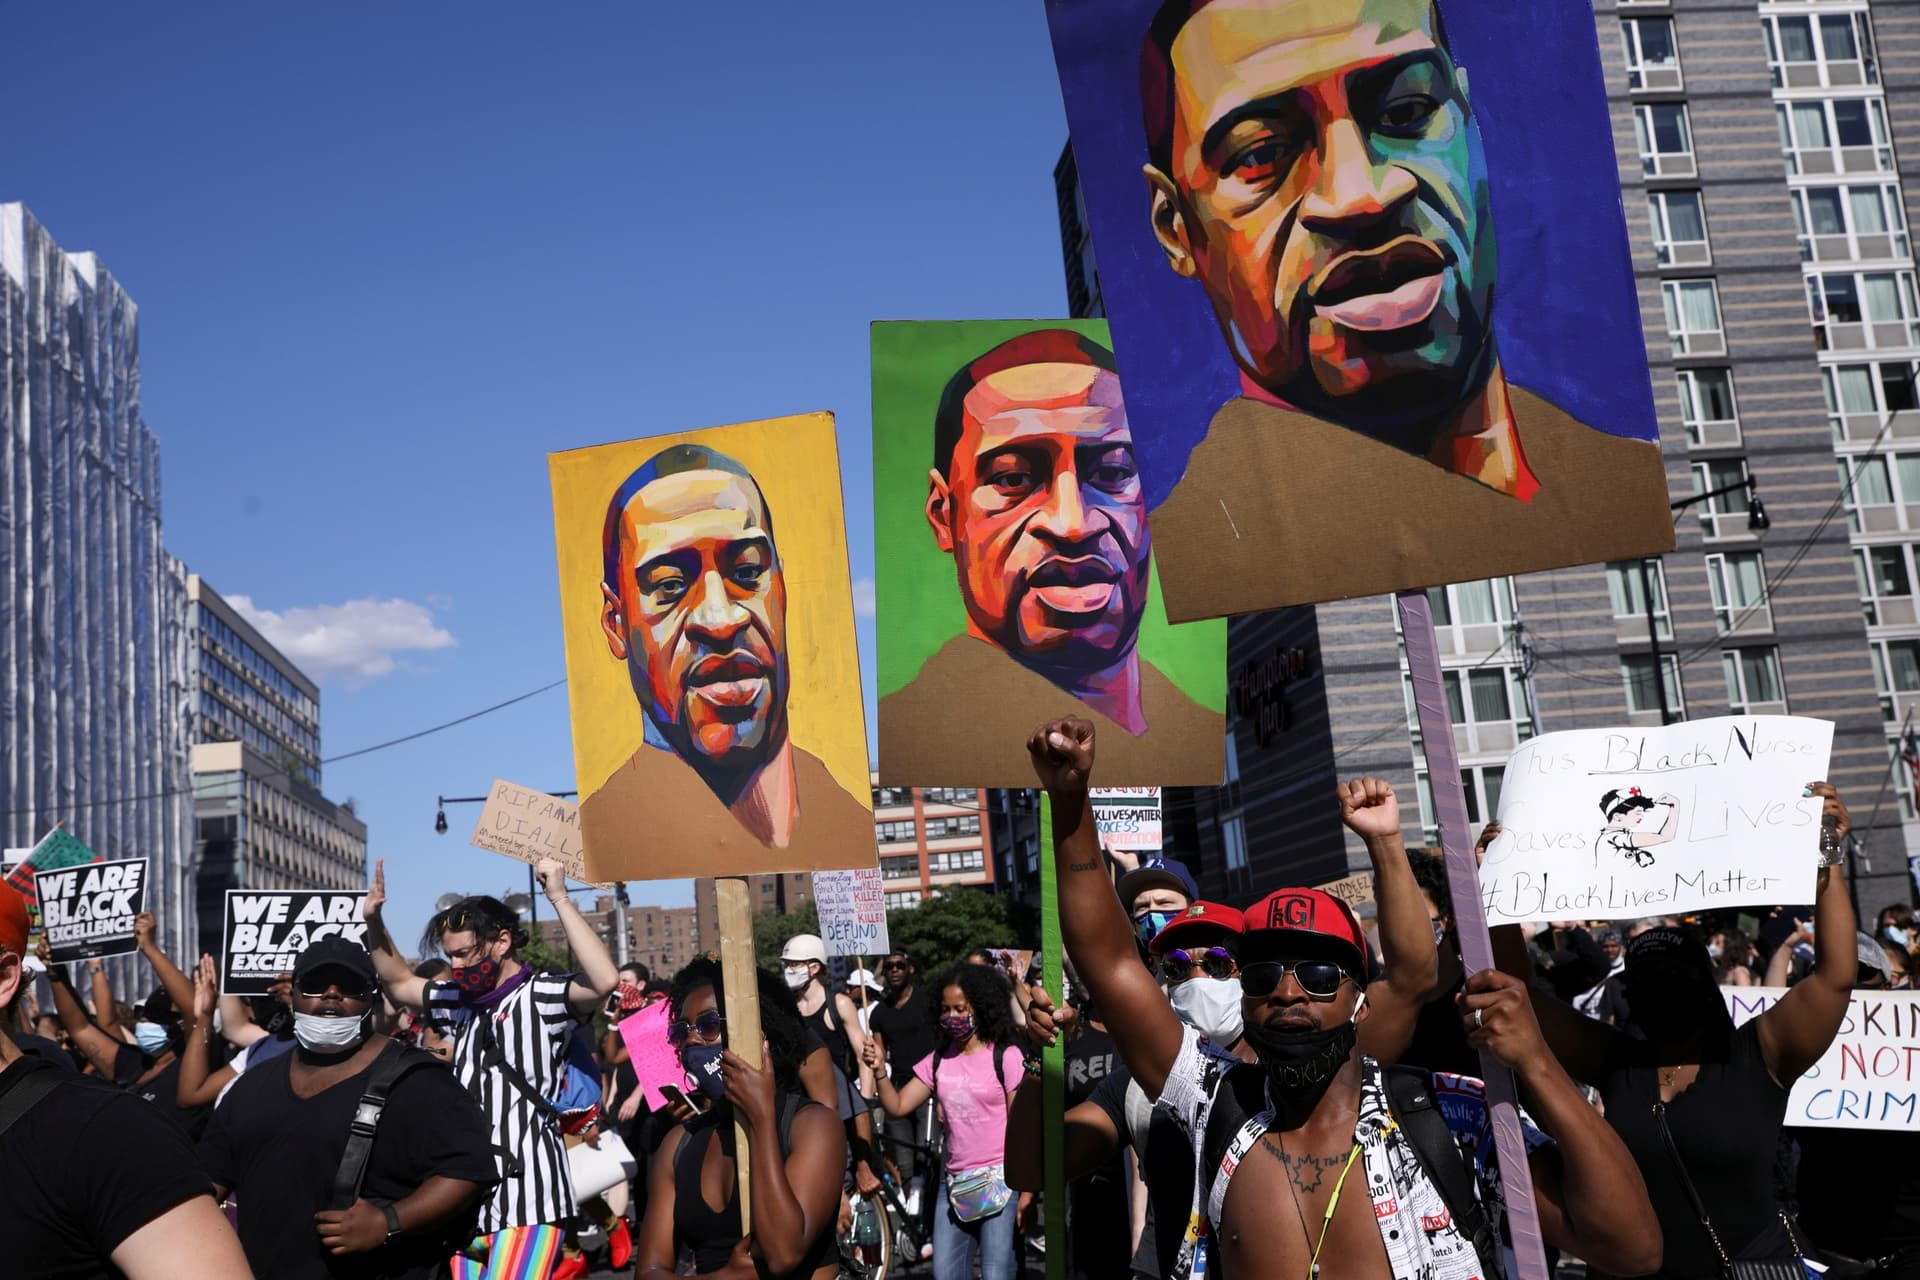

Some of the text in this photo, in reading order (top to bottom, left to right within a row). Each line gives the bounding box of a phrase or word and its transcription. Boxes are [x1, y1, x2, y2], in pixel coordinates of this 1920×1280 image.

[1508, 742, 1576, 785] This
[1723, 722, 1814, 764] Nurse
[497, 784, 583, 831] RIP AMA
[1094, 809, 1161, 823] KLIVESMATTER
[1688, 784, 1813, 842] Lives
[1096, 820, 1140, 833] ROCESS
[38, 863, 143, 901] WE ARE
[44, 888, 139, 929] BLACK
[232, 896, 292, 923] WE
[48, 915, 136, 943] EXCELLENCE
[828, 924, 877, 940] DEFUND
[231, 954, 296, 970] EXCEL
[836, 941, 868, 955] NYPD
[1732, 994, 1779, 1024] M
[1841, 1042, 1920, 1081] NOT
[1805, 1089, 1920, 1124] CRIM
